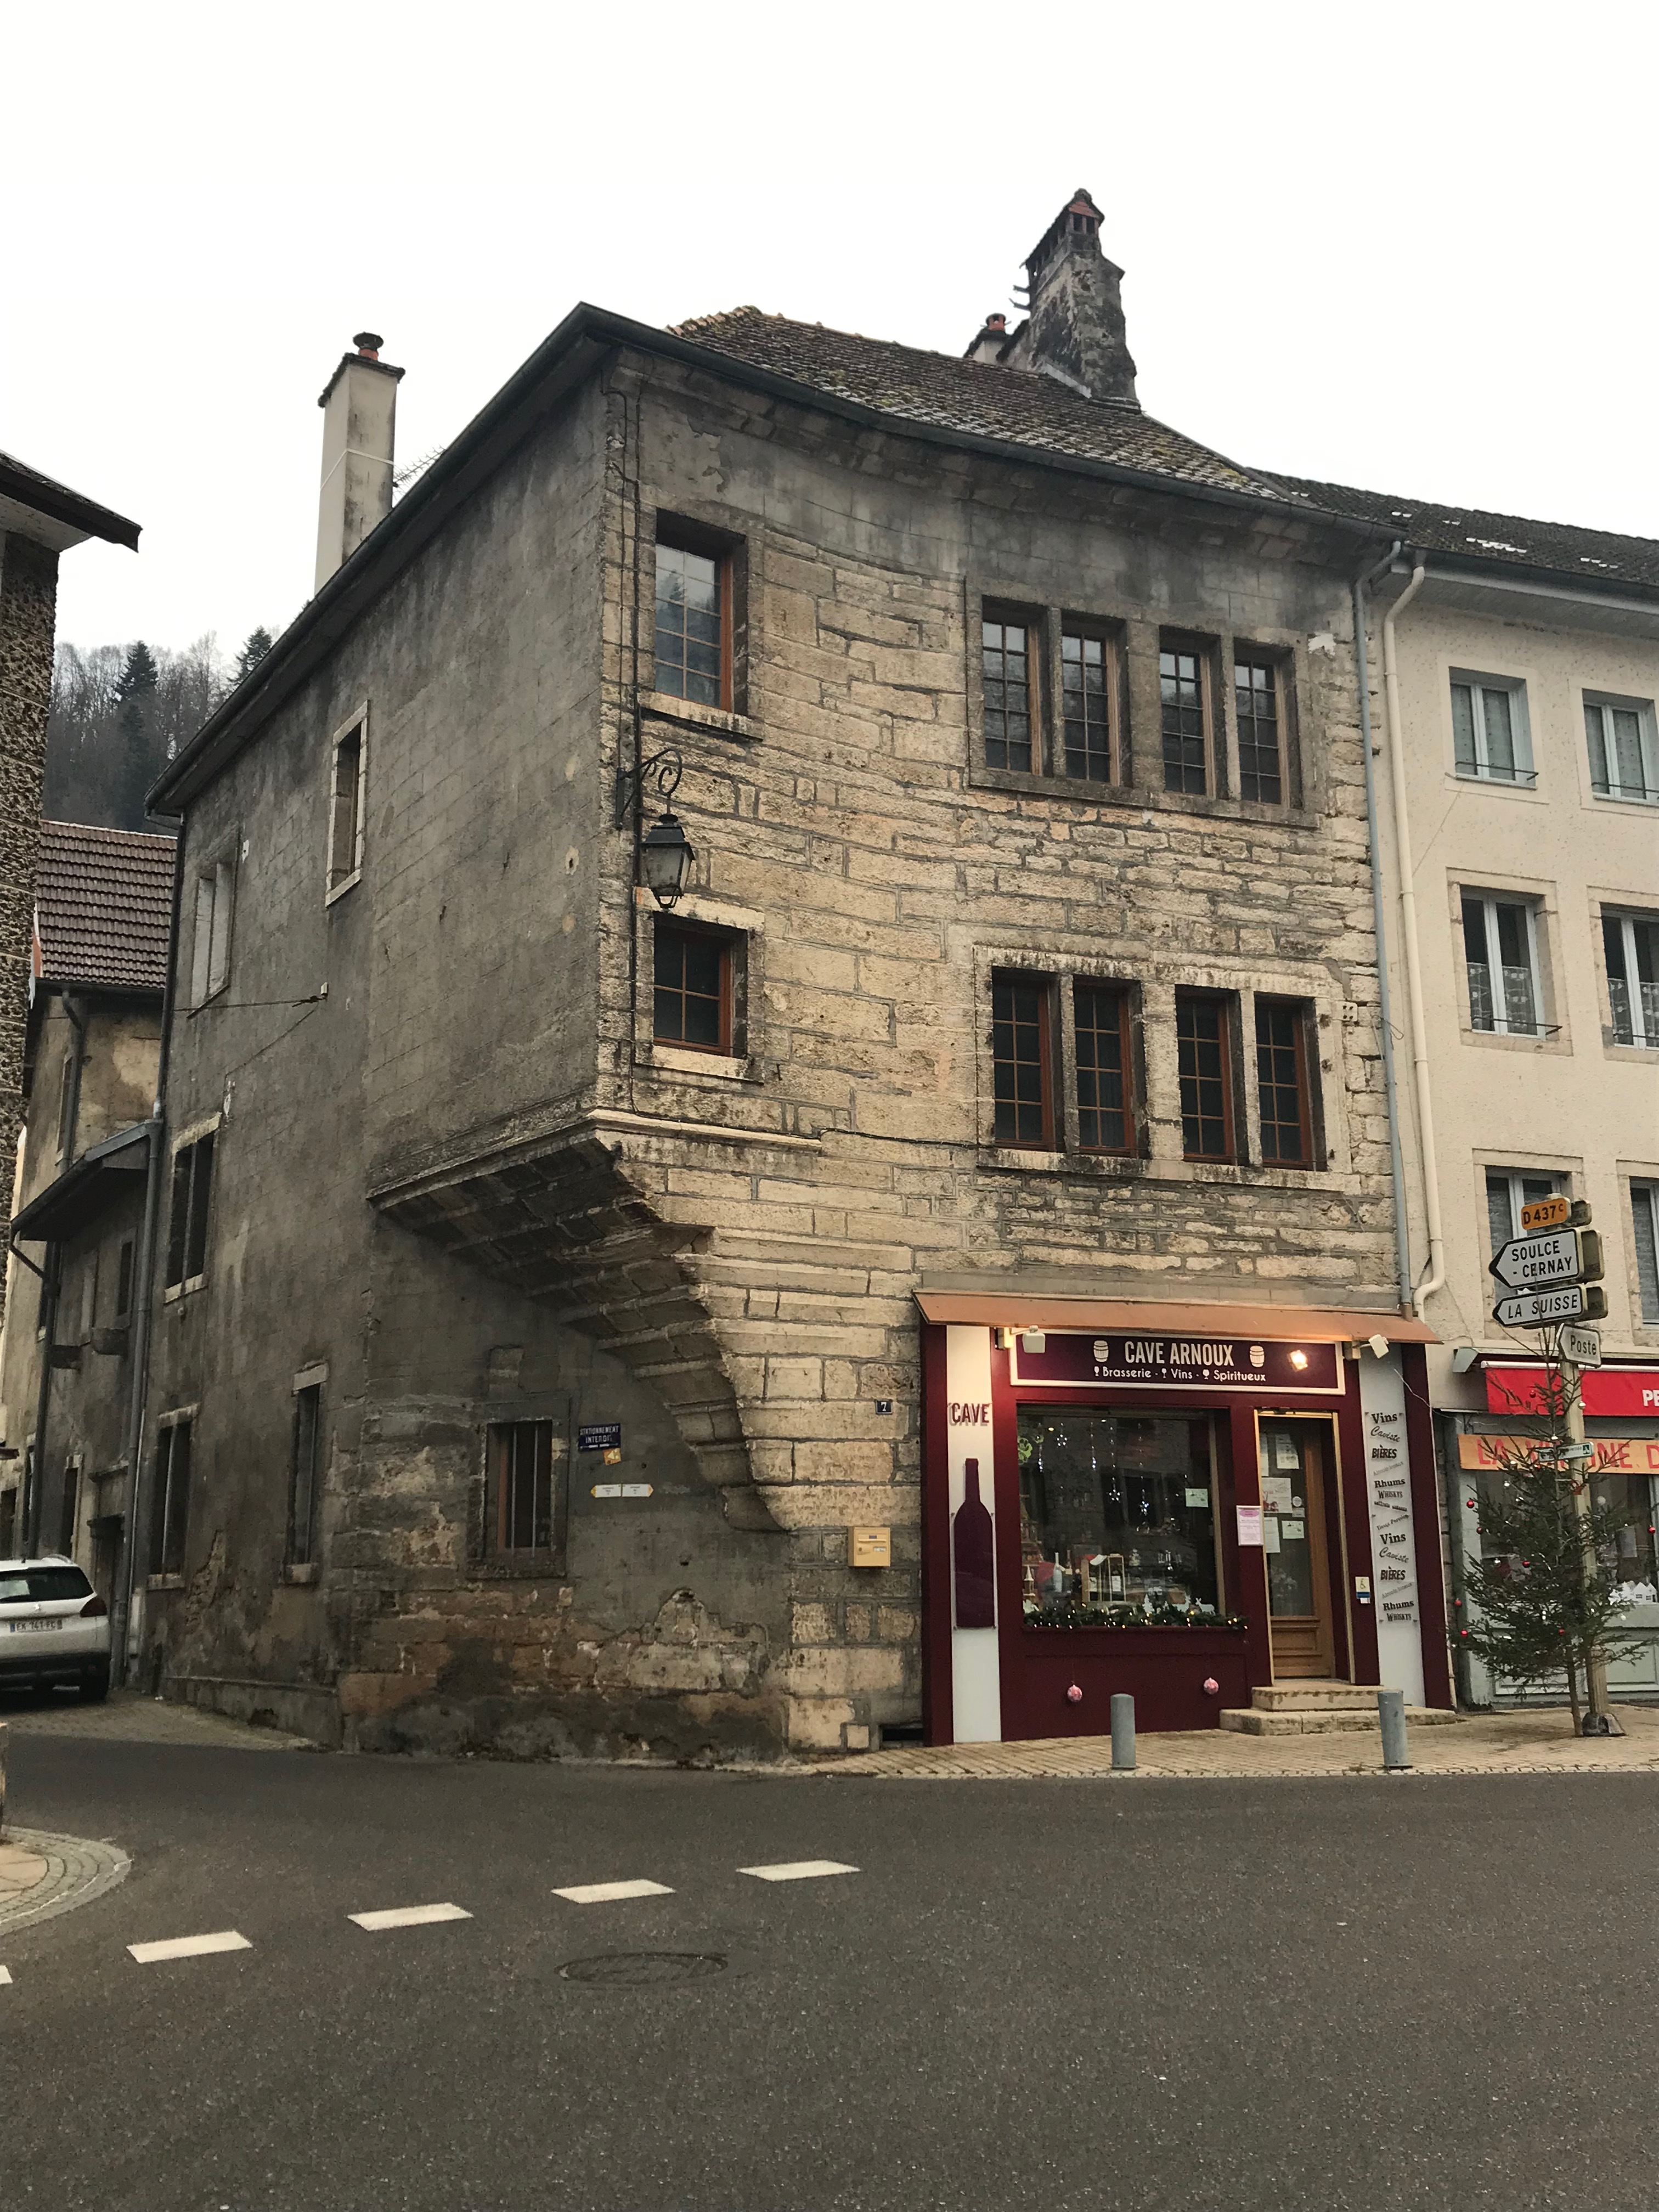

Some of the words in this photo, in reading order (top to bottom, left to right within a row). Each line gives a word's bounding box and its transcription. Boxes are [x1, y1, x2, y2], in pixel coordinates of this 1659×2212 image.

[1523, 1211, 1531, 1225] D
[1512, 1240, 1560, 1262] SOULCE
[1522, 1256, 1572, 1278] CERNAY
[1508, 1304, 1522, 1319] LA
[1532, 1294, 1578, 1314] SUISSE
[1570, 1335, 1596, 1356] Poste
[1125, 1341, 1165, 1364] CAVE
[1170, 1342, 1234, 1366] ARNOUX
[1102, 1367, 1152, 1378] Brasserie
[1171, 1368, 1193, 1379] Vins
[1213, 1370, 1266, 1382] Spiritueux
[881, 1402, 887, 1412] 7
[952, 1402, 990, 1423] CAVE
[1372, 1413, 1398, 1424] Vins
[579, 1425, 619, 1435] STATIONNEMENT
[1370, 1426, 1401, 1442] Caviste
[1372, 1444, 1397, 1459] BIÈRES
[1476, 1438, 1510, 1465] LA
[1374, 1479, 1406, 1488] Rhums
[1380, 1533, 1406, 1545] Vins
[1379, 1547, 1409, 1563] Caviste
[1380, 1566, 1406, 1581] BIÈRES
[1383, 1600, 1414, 1611] Rhums
